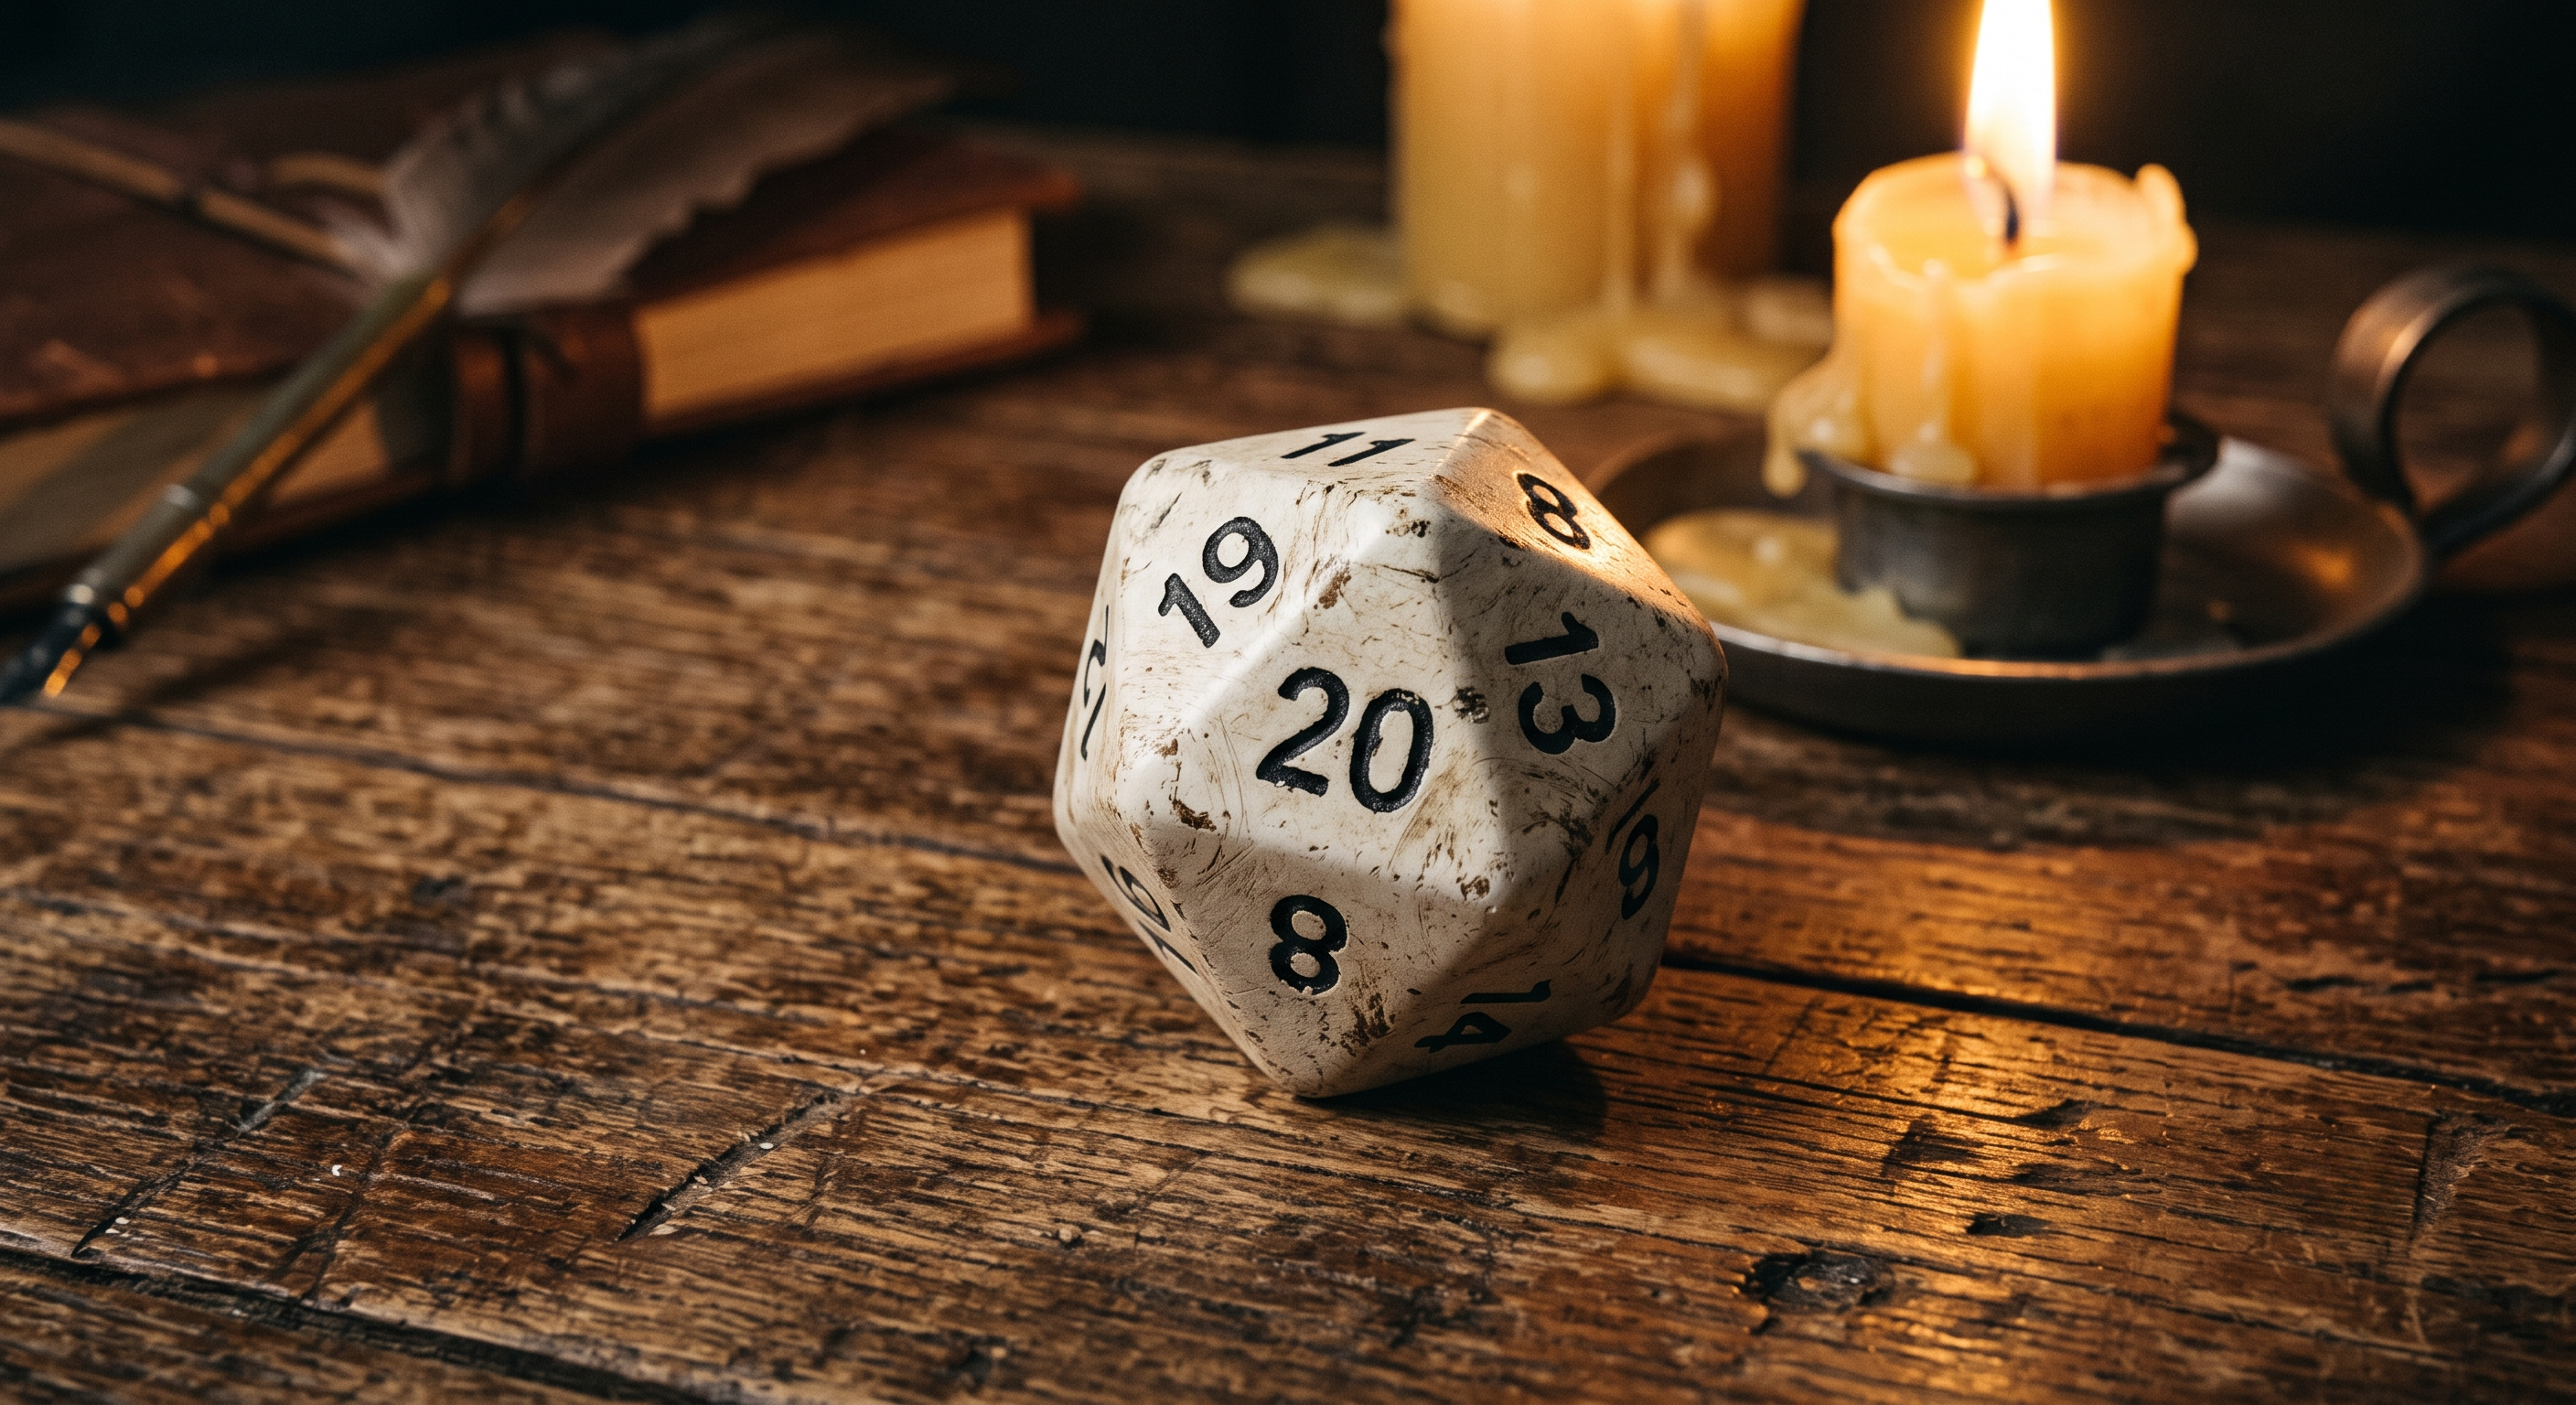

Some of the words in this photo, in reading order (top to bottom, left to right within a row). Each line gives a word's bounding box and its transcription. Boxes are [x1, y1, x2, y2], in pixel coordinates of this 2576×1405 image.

[1281, 432, 1416, 467] 11
[1517, 472, 1592, 551] 8
[1158, 516, 1280, 649] 19
[1505, 611, 1616, 756] 13
[1256, 666, 1435, 813] 20
[1269, 894, 1349, 996] 8
[1414, 979, 1551, 1053] 14
